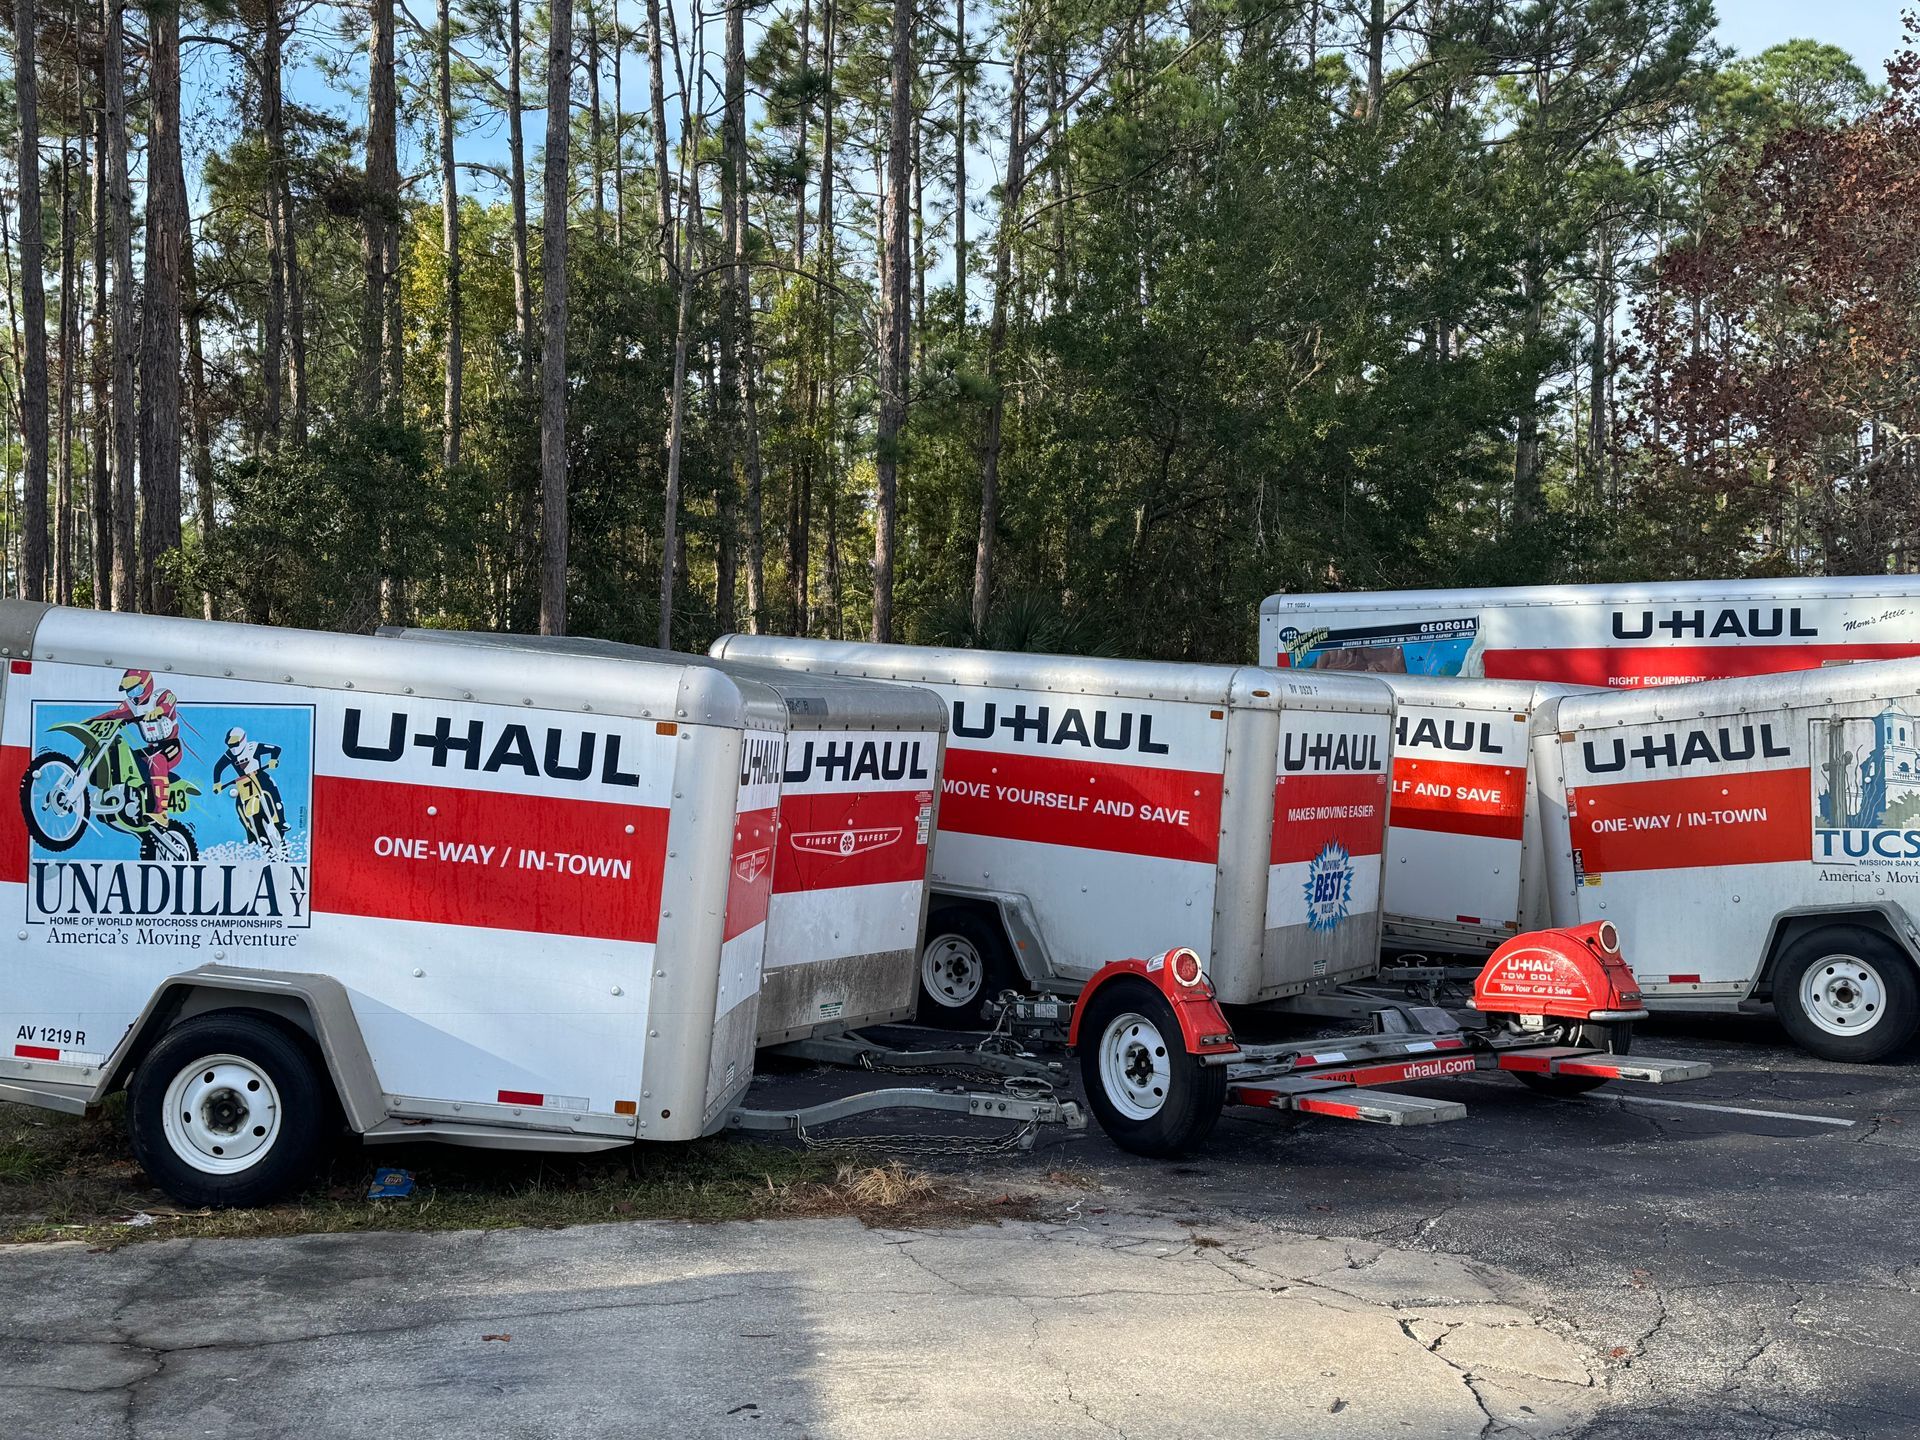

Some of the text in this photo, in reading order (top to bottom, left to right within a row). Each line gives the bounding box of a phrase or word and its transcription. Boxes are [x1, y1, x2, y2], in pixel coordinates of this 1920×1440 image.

[1420, 620, 1474, 632] GEORGIA
[1612, 608, 1818, 639] U-HAUL
[1843, 609, 1906, 631] Mom's Attic
[1282, 630, 1297, 640] #122
[1294, 632, 1328, 667] America
[1608, 676, 1640, 685] RIGHT
[953, 701, 1170, 754] U-HAUL
[342, 708, 640, 788] U-HAUL
[1284, 732, 1381, 771] U-HAUL
[1583, 724, 1790, 774] U-HAUL
[783, 741, 928, 782] U-HAUL
[168, 790, 186, 812] 43
[940, 778, 990, 798] MOVE
[996, 786, 1088, 812] YOURSELF
[1093, 800, 1134, 818] AND
[1140, 804, 1190, 826] SAVE
[1414, 783, 1451, 797] AND
[1456, 787, 1501, 803] SAVE
[1288, 805, 1374, 822] MAKES MOVING EASIER
[1591, 808, 1767, 834] ONE-WAY / IN-TOWN
[806, 833, 889, 846] FINEST SAFEST
[374, 836, 631, 880] ONE-WAY / IN-TOWN
[1314, 871, 1344, 903] BEST
[1819, 870, 1880, 882] America's
[32, 862, 282, 916] UNADILLA
[50, 917, 283, 928] HOME OF WORLD MOTOCROSS CHAMPIONSHIPS
[46, 927, 297, 949] America's Moving Adventure
[1501, 972, 1525, 980] TOW
[1508, 959, 1554, 972] U-HAU
[1500, 984, 1514, 992] Tow
[1547, 986, 1552, 994] &
[1555, 987, 1572, 995] Save
[17, 1025, 86, 1045] AV 1219 R
[1404, 1059, 1476, 1078] uhaul.com
